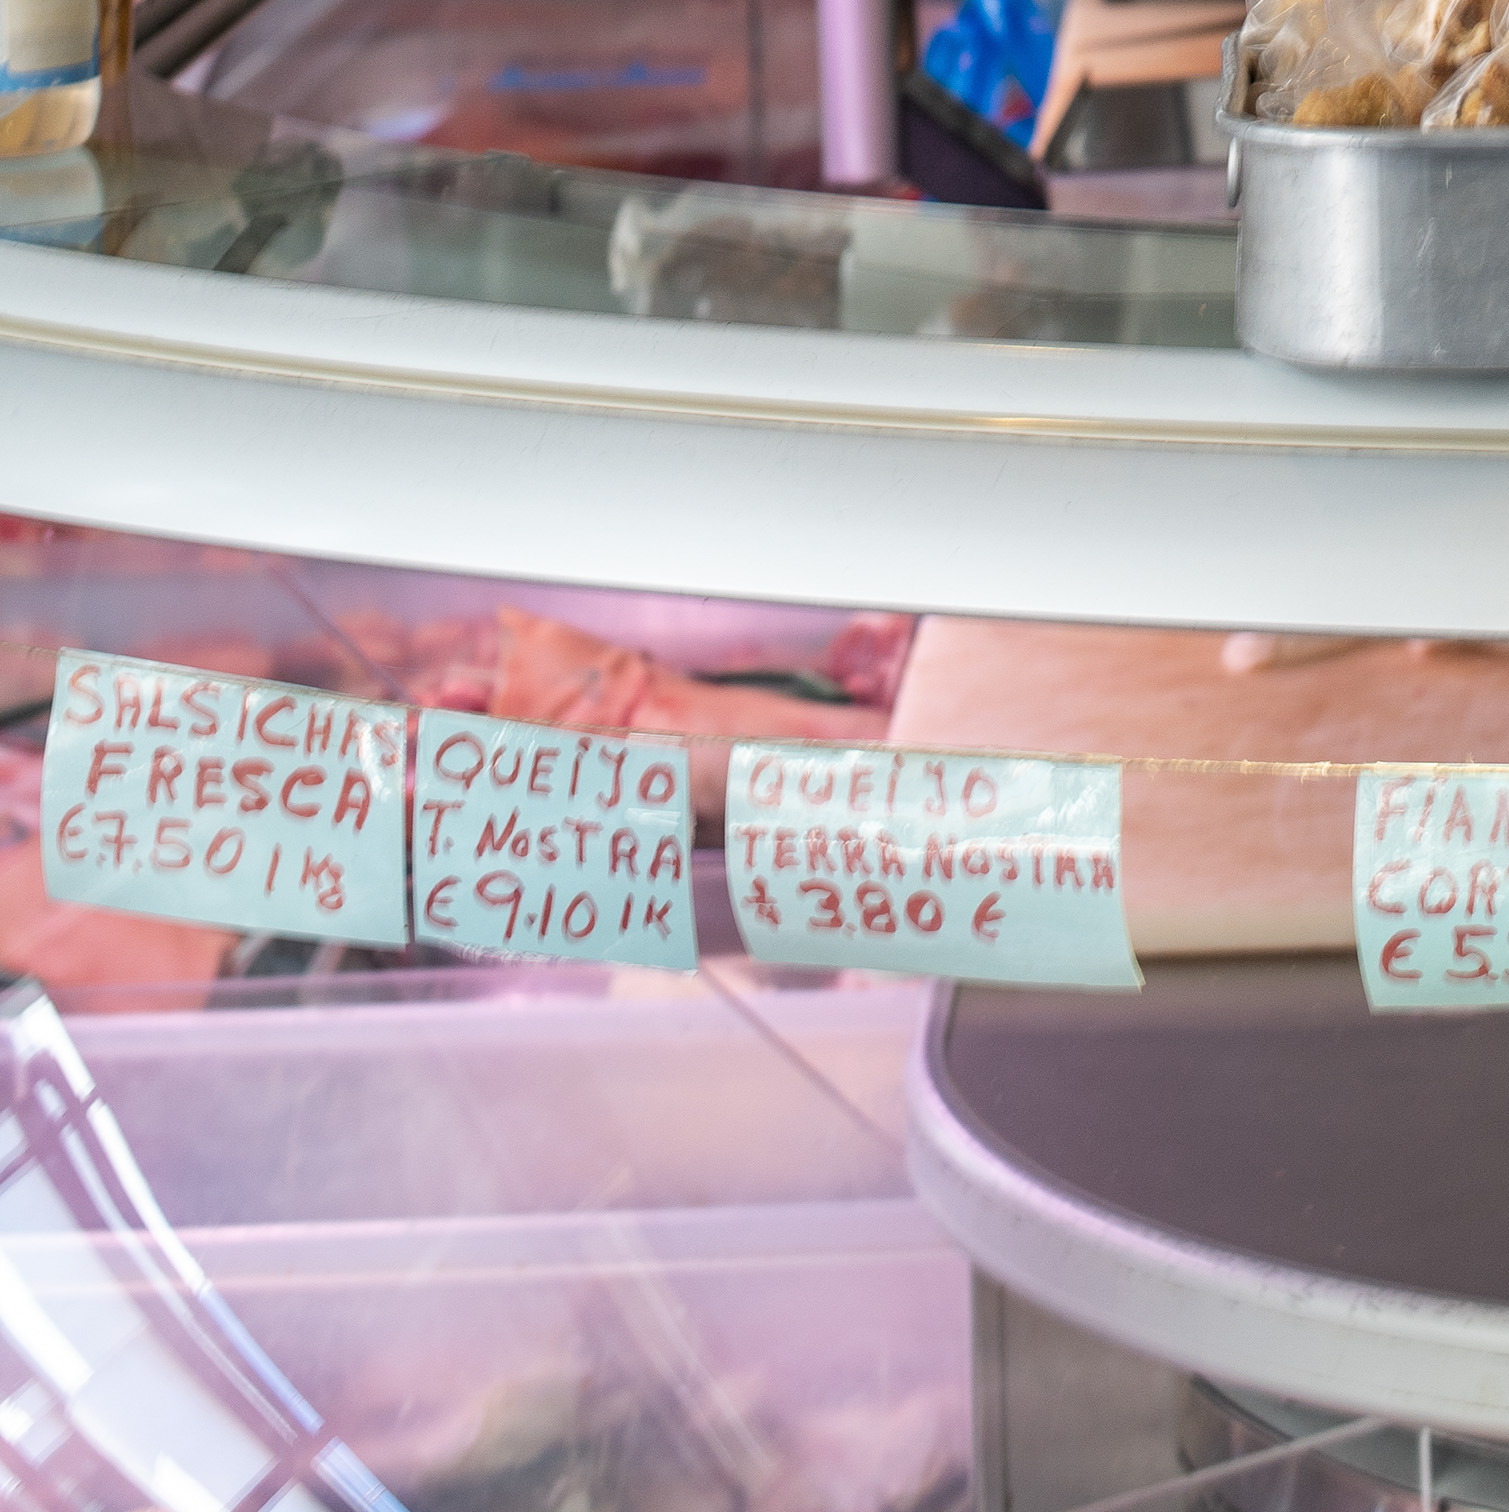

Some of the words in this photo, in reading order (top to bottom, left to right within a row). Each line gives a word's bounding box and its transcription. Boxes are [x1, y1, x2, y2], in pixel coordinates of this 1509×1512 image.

[85, 738, 372, 833] FRESCA
[475, 806, 684, 883] NOSTRA
[736, 823, 908, 880] TERRA
